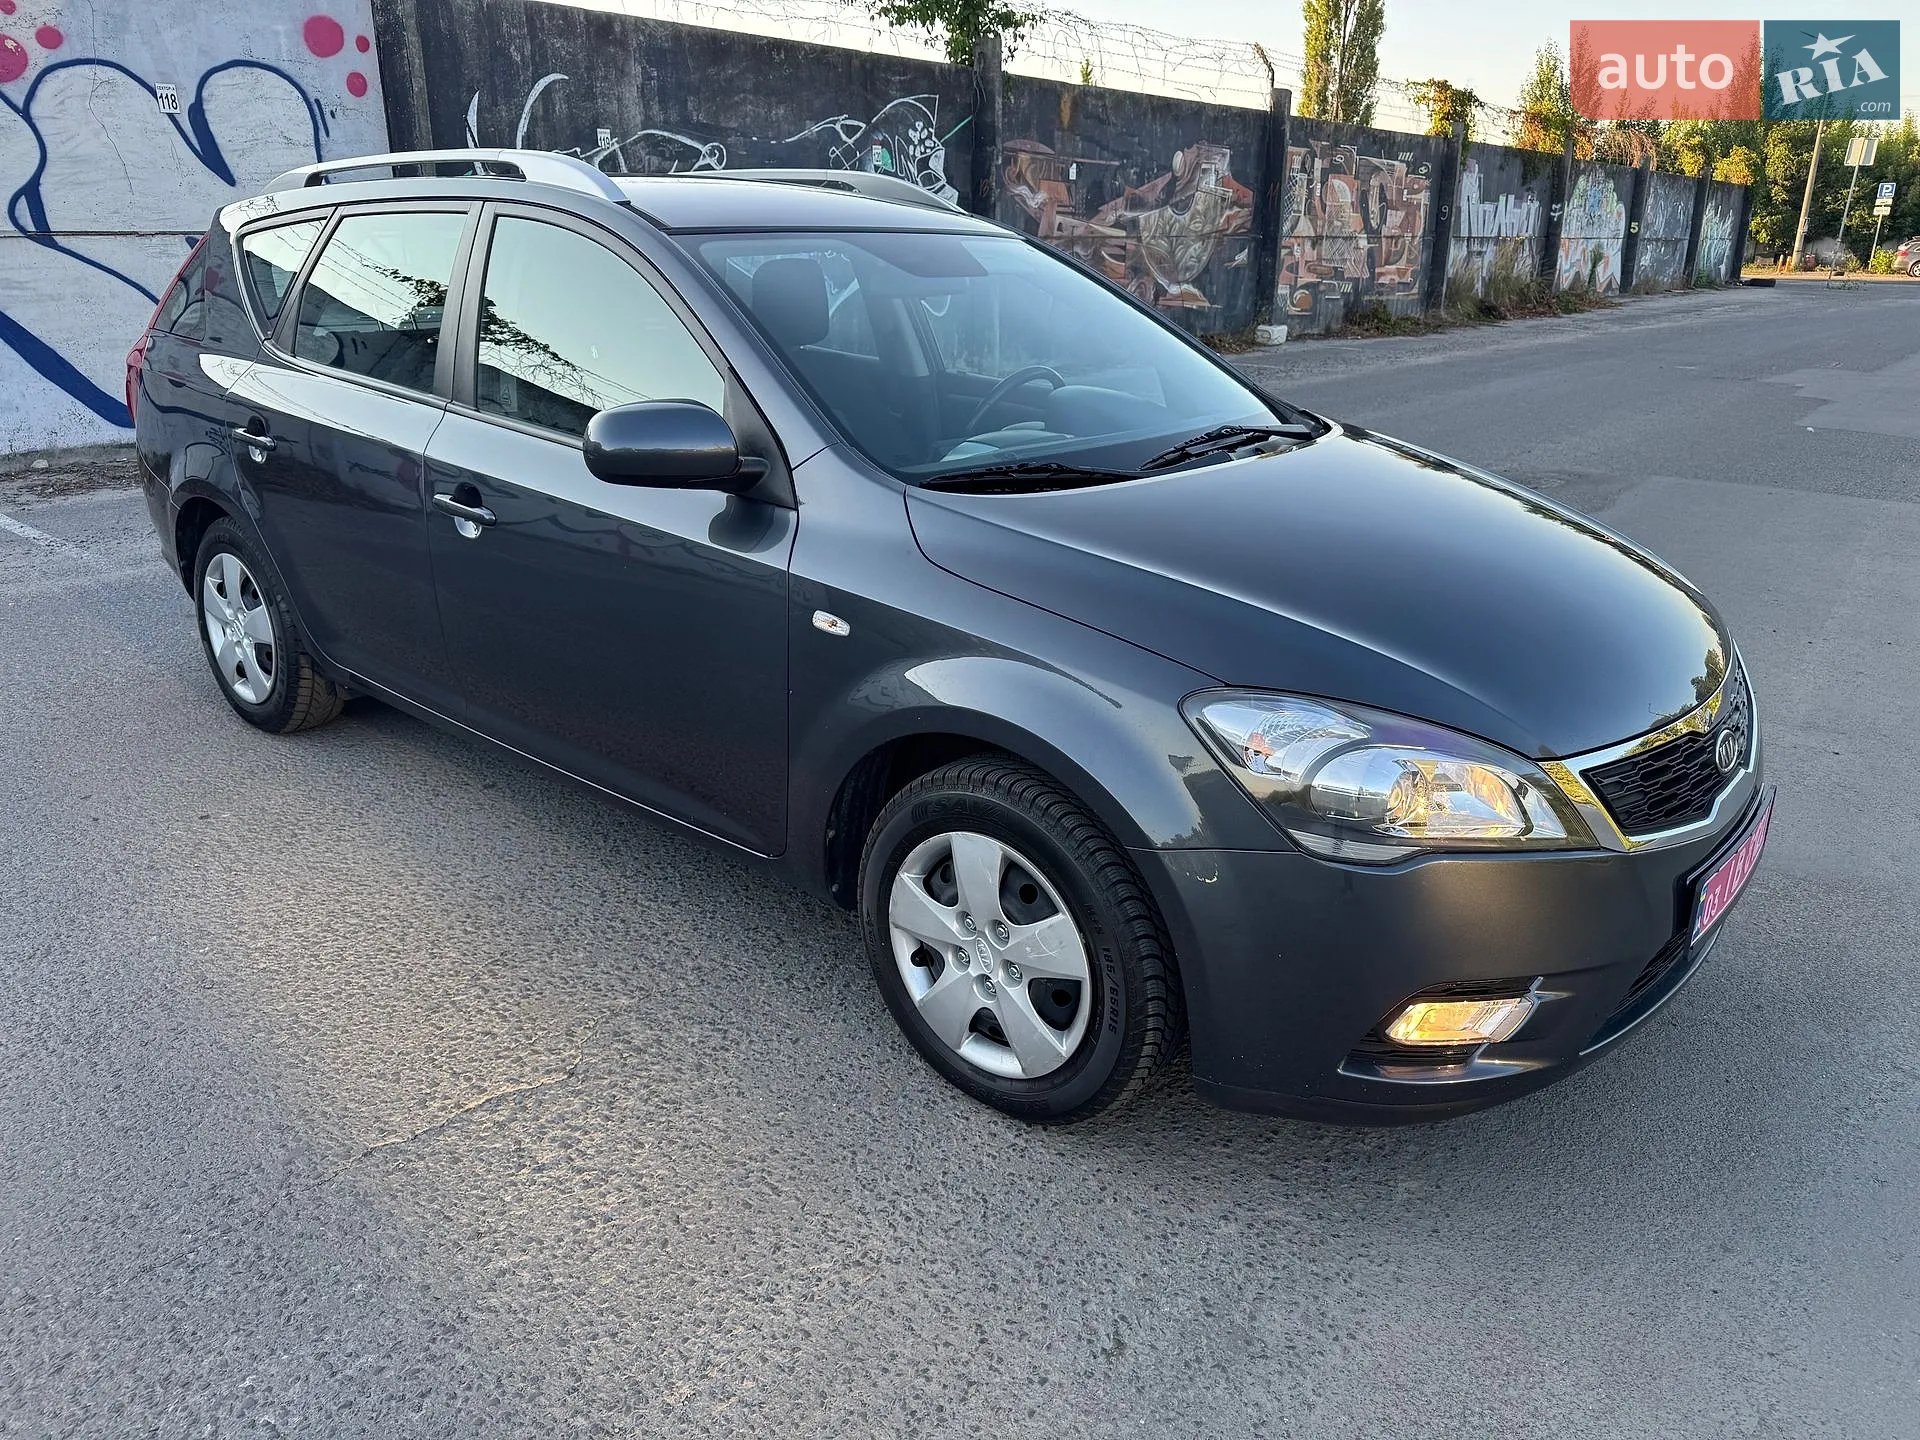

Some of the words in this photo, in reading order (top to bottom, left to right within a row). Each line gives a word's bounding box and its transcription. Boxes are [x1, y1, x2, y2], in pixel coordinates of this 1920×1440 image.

[159, 93, 178, 110] 118
[599, 136, 610, 150] 119
[1441, 204, 1449, 220] 9
[1630, 222, 1639, 233] 5
[1703, 884, 1721, 926] 03
